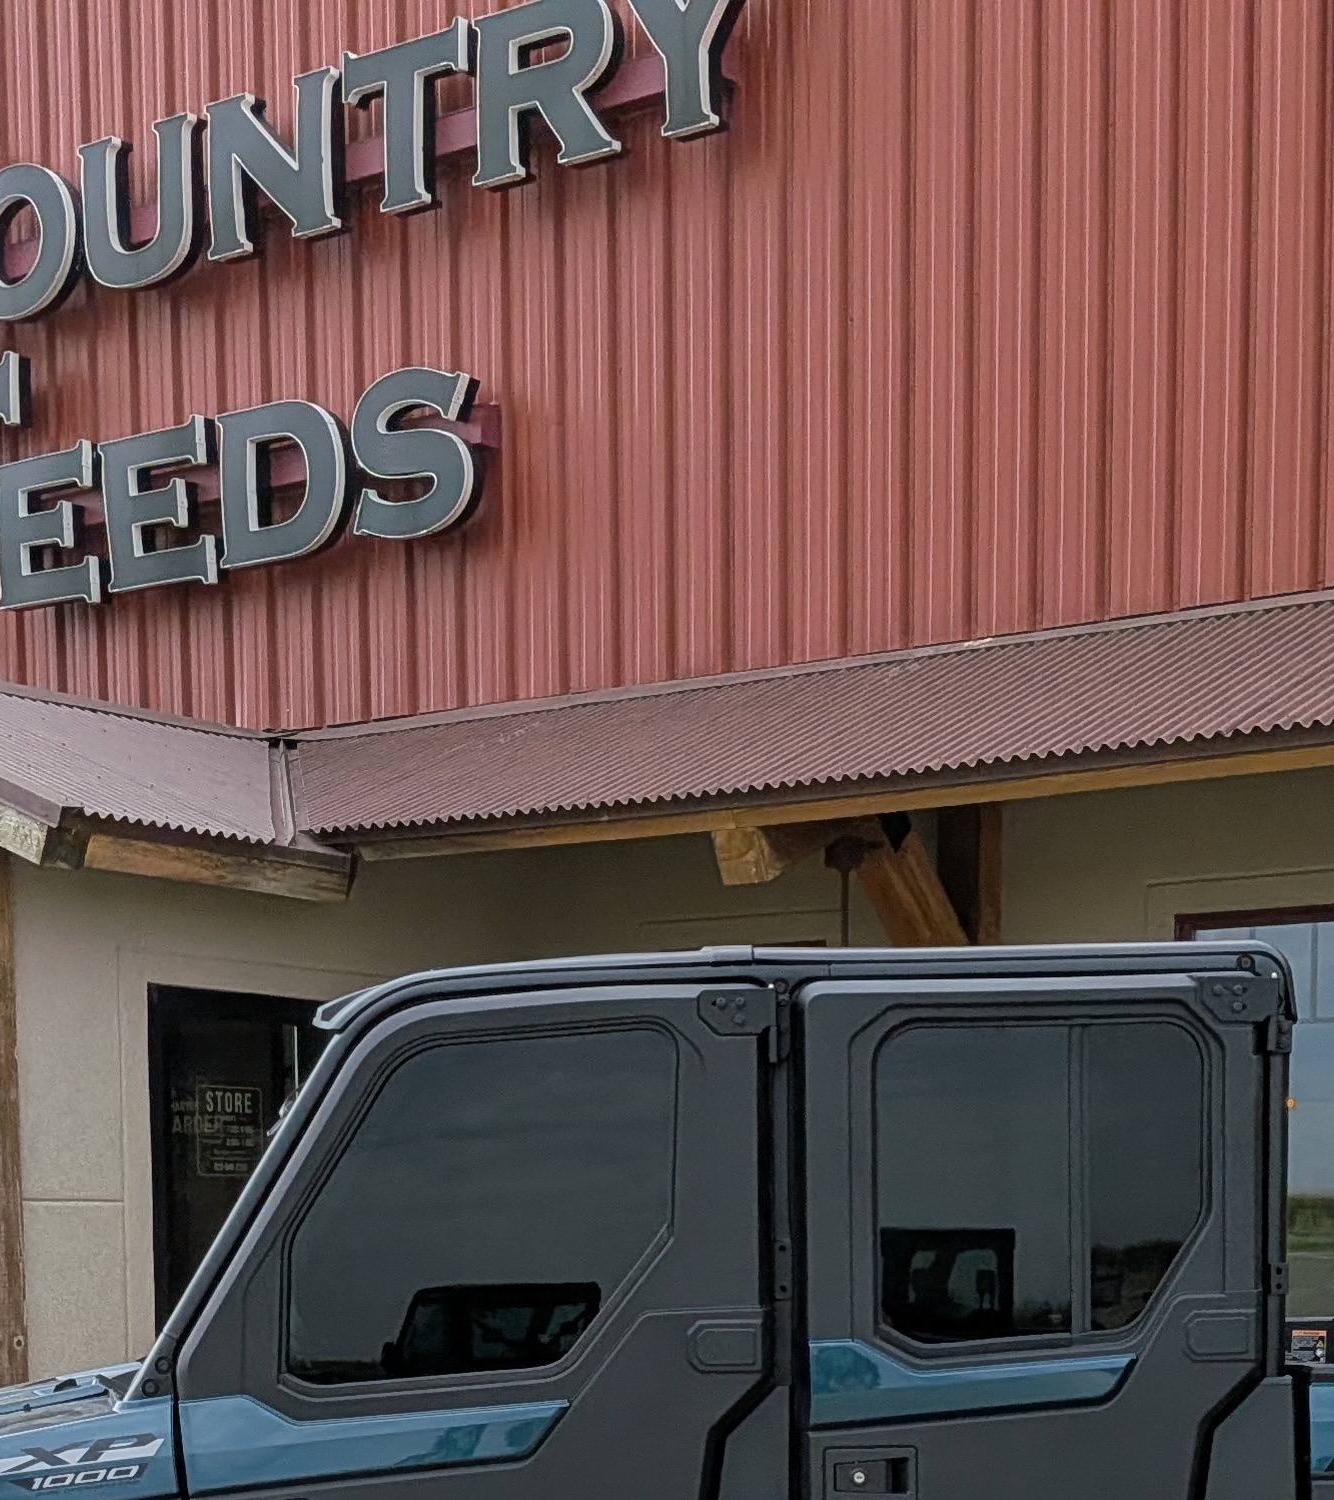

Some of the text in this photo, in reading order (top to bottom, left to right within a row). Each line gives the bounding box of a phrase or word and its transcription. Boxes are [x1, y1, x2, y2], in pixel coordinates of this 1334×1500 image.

[205, 1090, 253, 1114] STORE
[1, 1433, 158, 1474] XP
[31, 1464, 140, 1490] 1000
